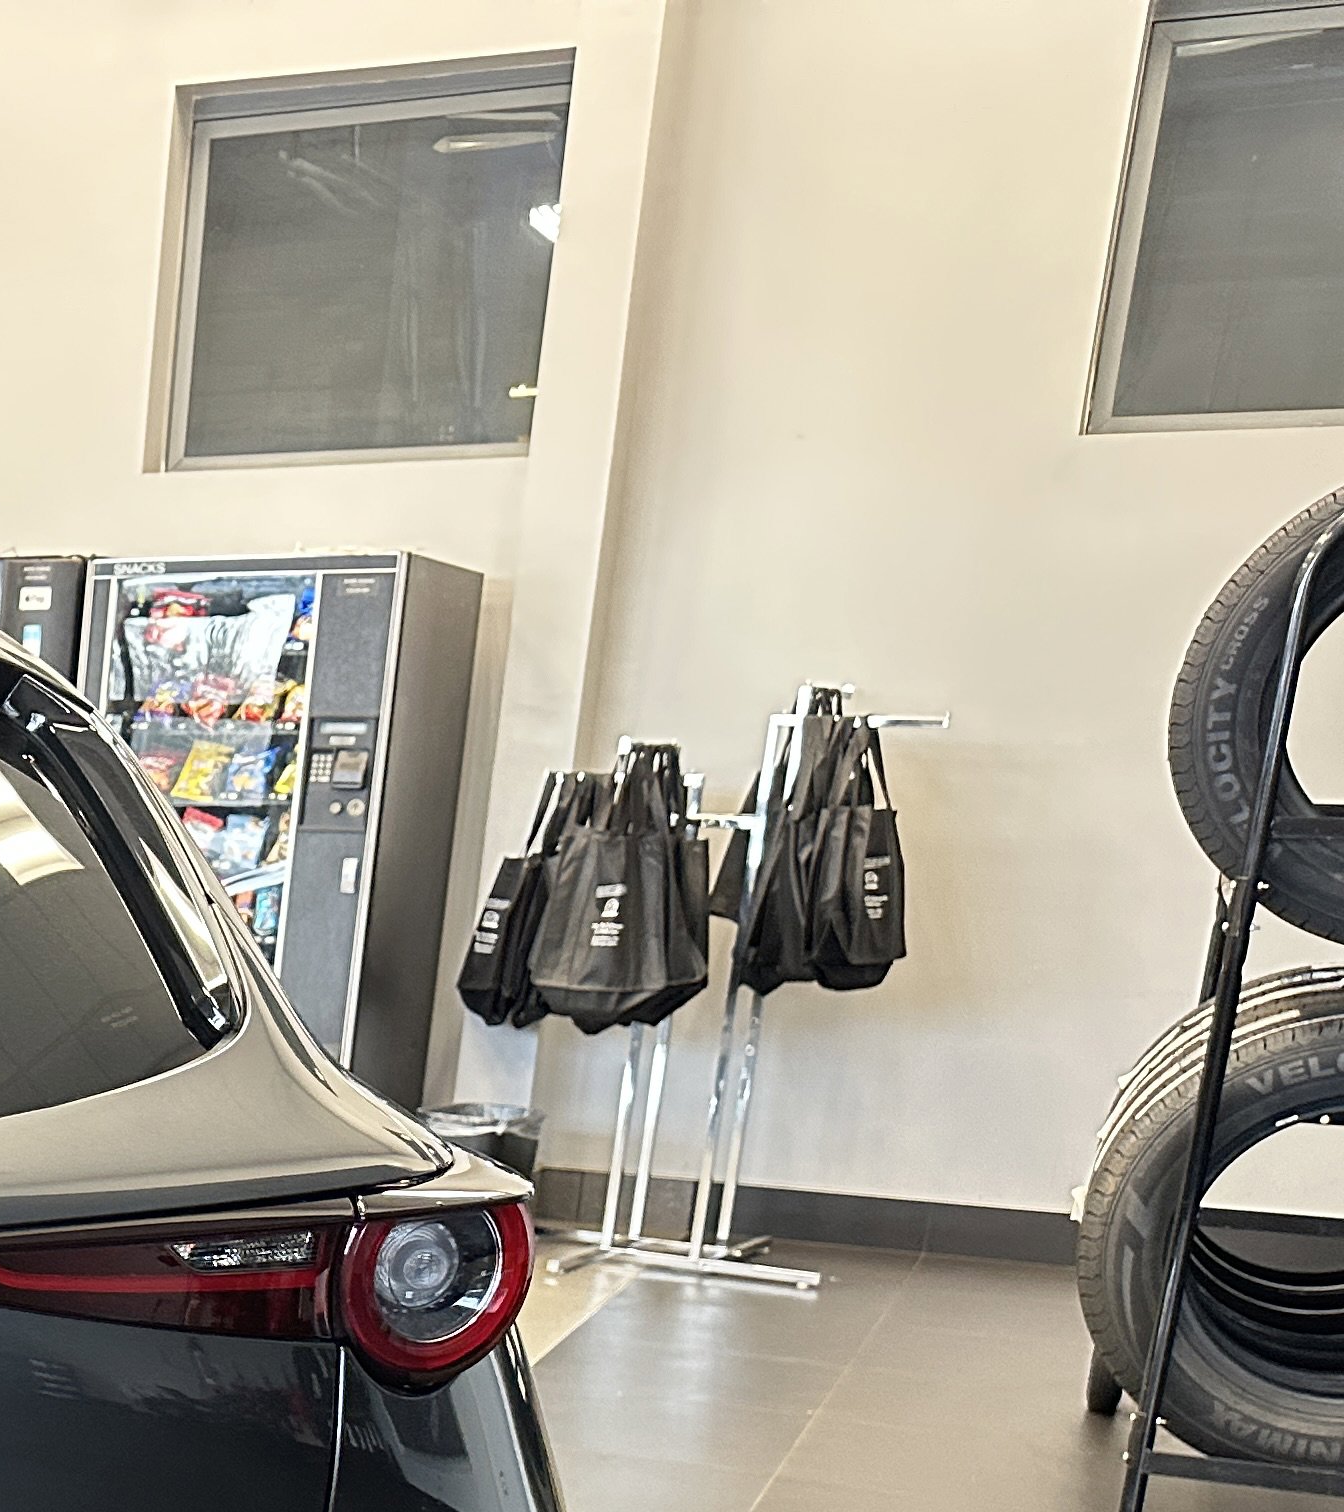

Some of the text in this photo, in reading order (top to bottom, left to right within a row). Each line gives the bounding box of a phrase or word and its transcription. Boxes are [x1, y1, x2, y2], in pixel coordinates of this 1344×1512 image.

[113, 561, 167, 576] SNACKS
[1219, 595, 1270, 671] CROSS
[1246, 1051, 1344, 1097] VEL
